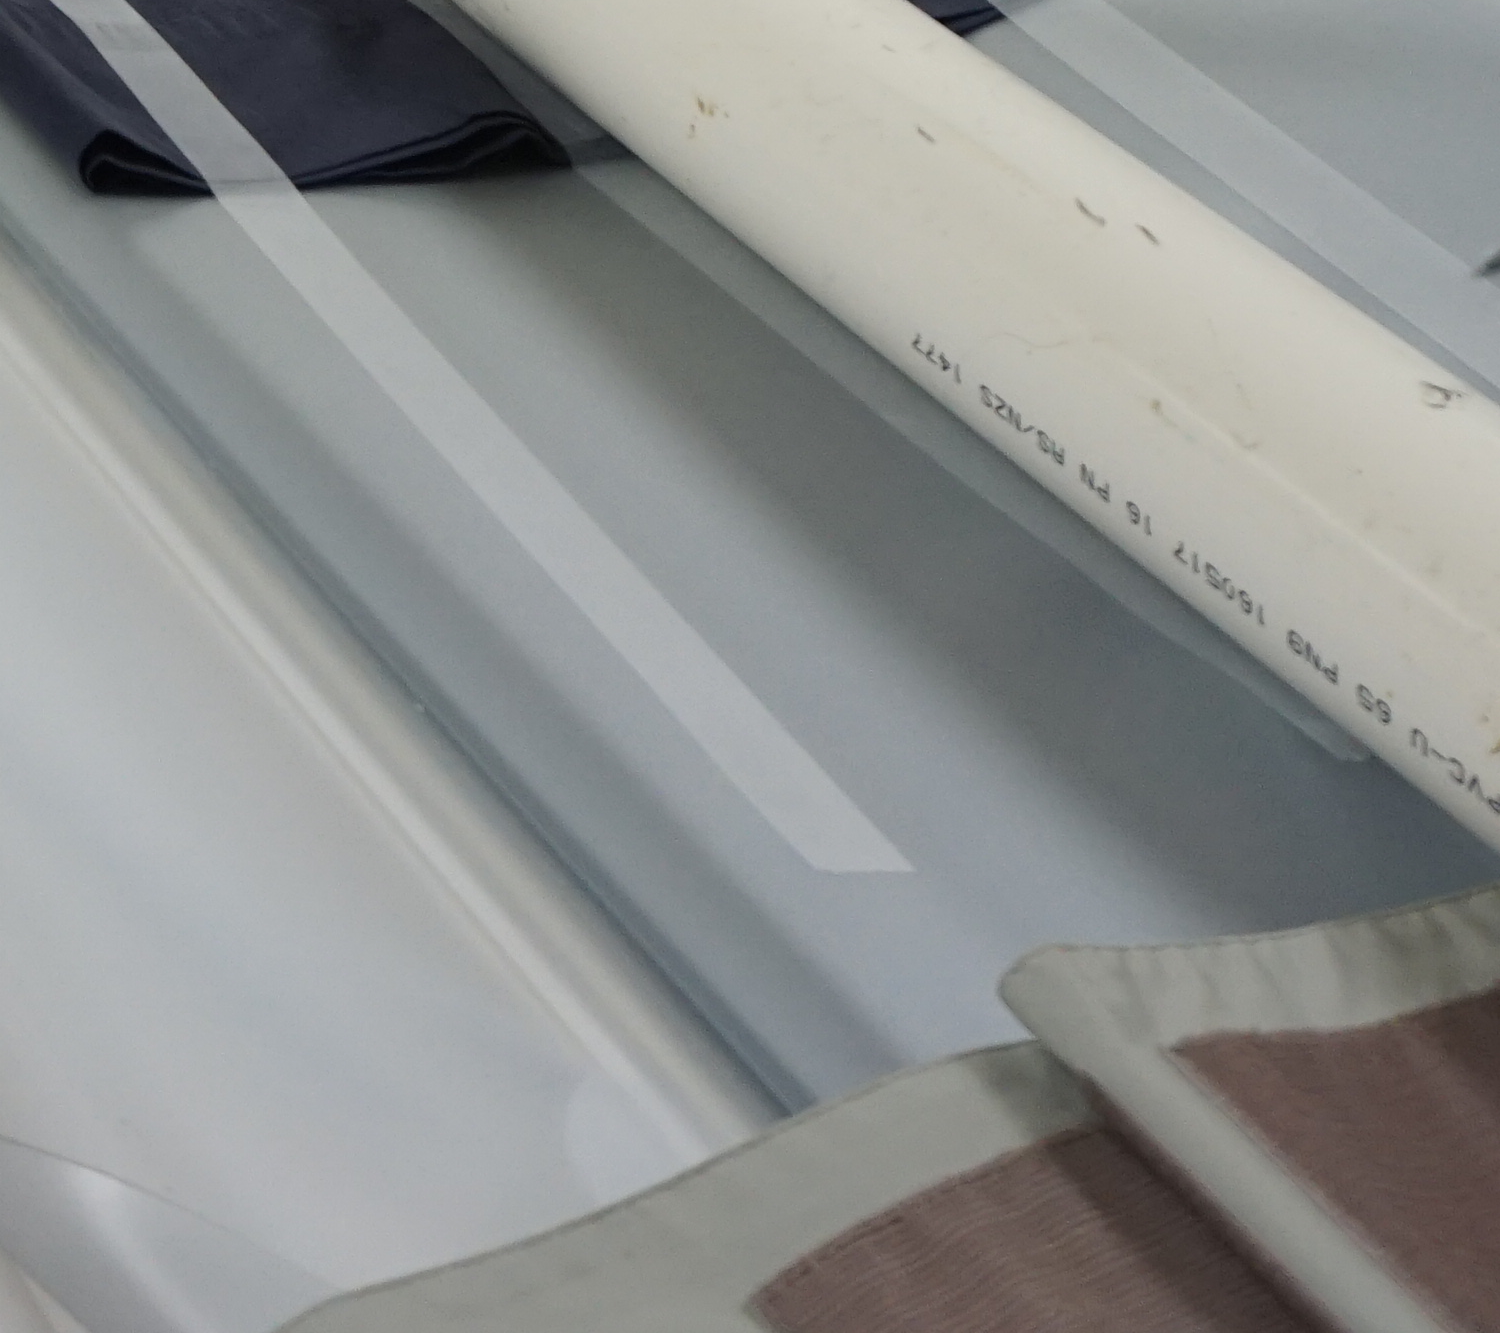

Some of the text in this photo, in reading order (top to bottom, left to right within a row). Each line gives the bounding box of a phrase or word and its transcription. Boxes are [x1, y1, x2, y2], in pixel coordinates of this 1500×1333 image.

[911, 333, 962, 385] 1477
[979, 383, 1066, 466] AS/NZS
[1079, 461, 1111, 504] PN
[1125, 499, 1153, 535] 16
[1287, 630, 1339, 685] PN9
